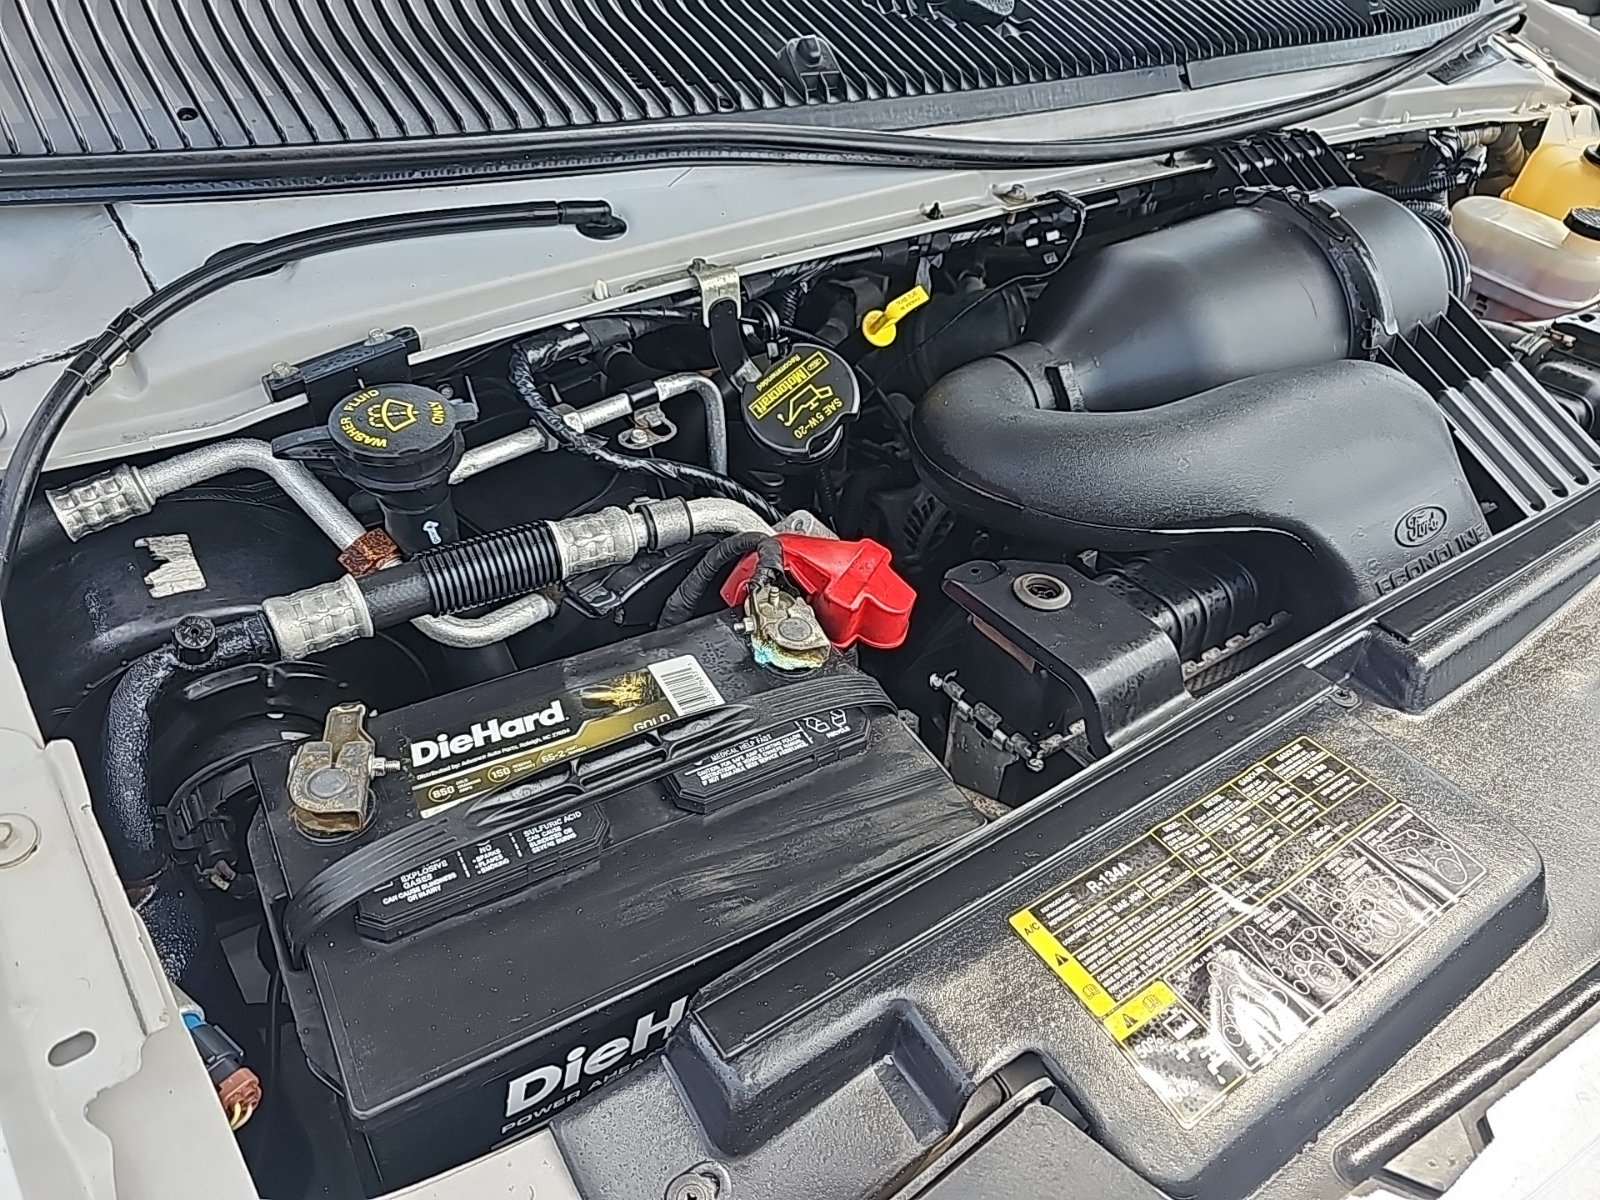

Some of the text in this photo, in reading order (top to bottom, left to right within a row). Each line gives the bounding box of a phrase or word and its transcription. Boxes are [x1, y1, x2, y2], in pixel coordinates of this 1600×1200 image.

[756, 354, 801, 391] Recommended
[343, 389, 380, 412] FLUID
[751, 367, 808, 414] Motorcraft
[427, 401, 445, 425] ONLY
[822, 398, 843, 416] SAE
[340, 416, 388, 448] WASHER
[1406, 511, 1438, 542] Ford
[540, 749, 566, 763] 65-2
[709, 733, 772, 761] MEDICAL HELP FAST
[416, 765, 451, 781] Distributed
[460, 754, 486, 766] Advance
[486, 749, 501, 758] Auto
[490, 766, 511, 779] 150
[432, 785, 455, 799] 850
[522, 810, 582, 837] SULFURIC ACID
[526, 825, 562, 842] CAN CAUSE
[478, 844, 492, 853] NO
[400, 859, 448, 882] EXPLOSIVE
[402, 873, 433, 889] GASES
[1085, 862, 1133, 894] R-134A
[382, 894, 398, 904] CAN
[397, 886, 421, 898] CAUSE
[406, 893, 418, 902] OR
[1111, 898, 1130, 913] SAE
[1023, 921, 1041, 936] A/C
[1133, 1033, 1165, 1059] 50%
[502, 1090, 580, 1134] POWER
